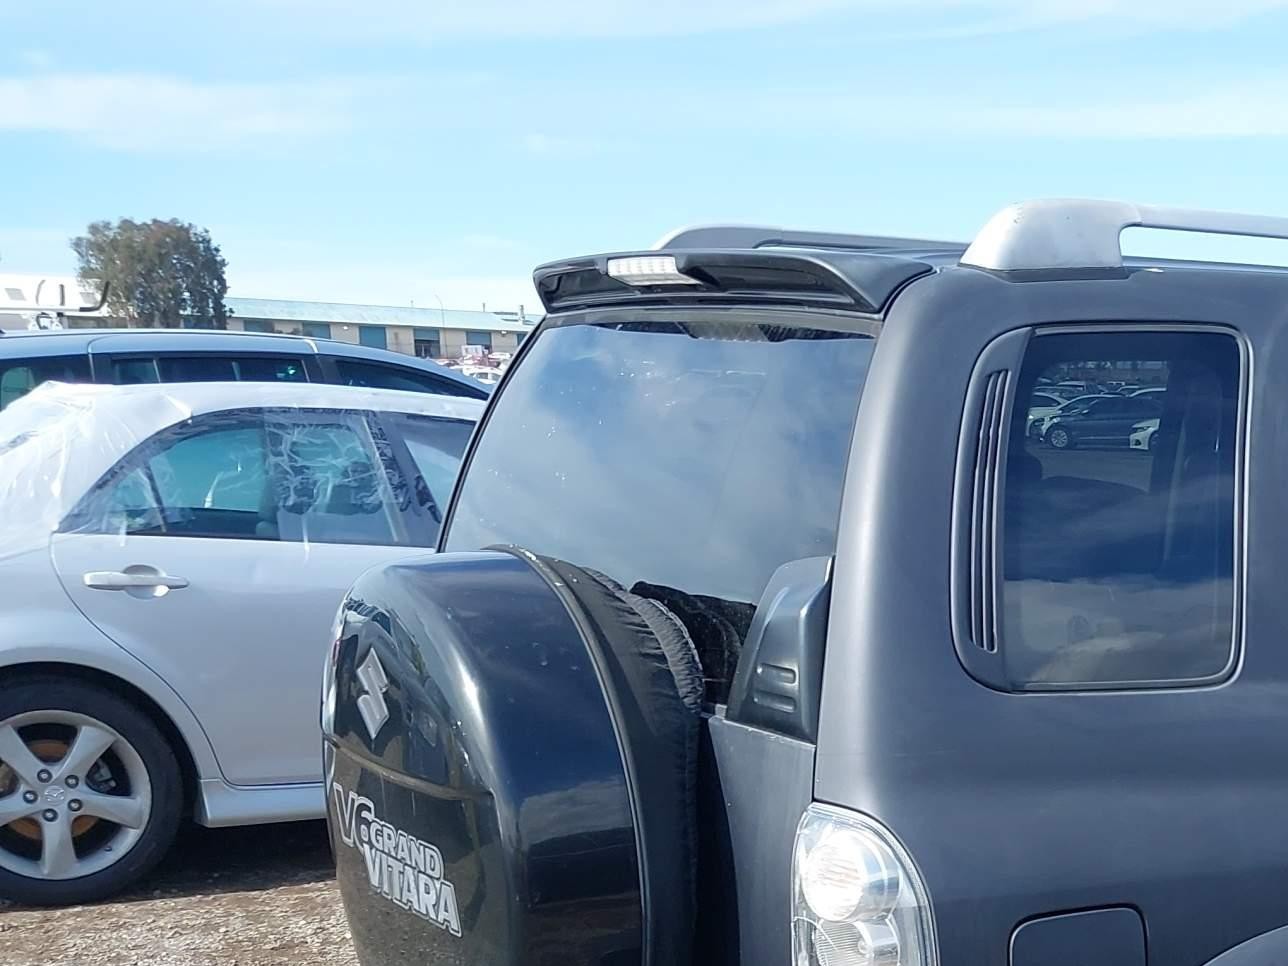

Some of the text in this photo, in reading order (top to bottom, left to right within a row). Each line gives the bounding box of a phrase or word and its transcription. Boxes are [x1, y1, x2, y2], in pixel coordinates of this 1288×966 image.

[333, 783, 374, 854] V6
[367, 819, 444, 880] GRAND
[363, 843, 461, 936] VITARA
